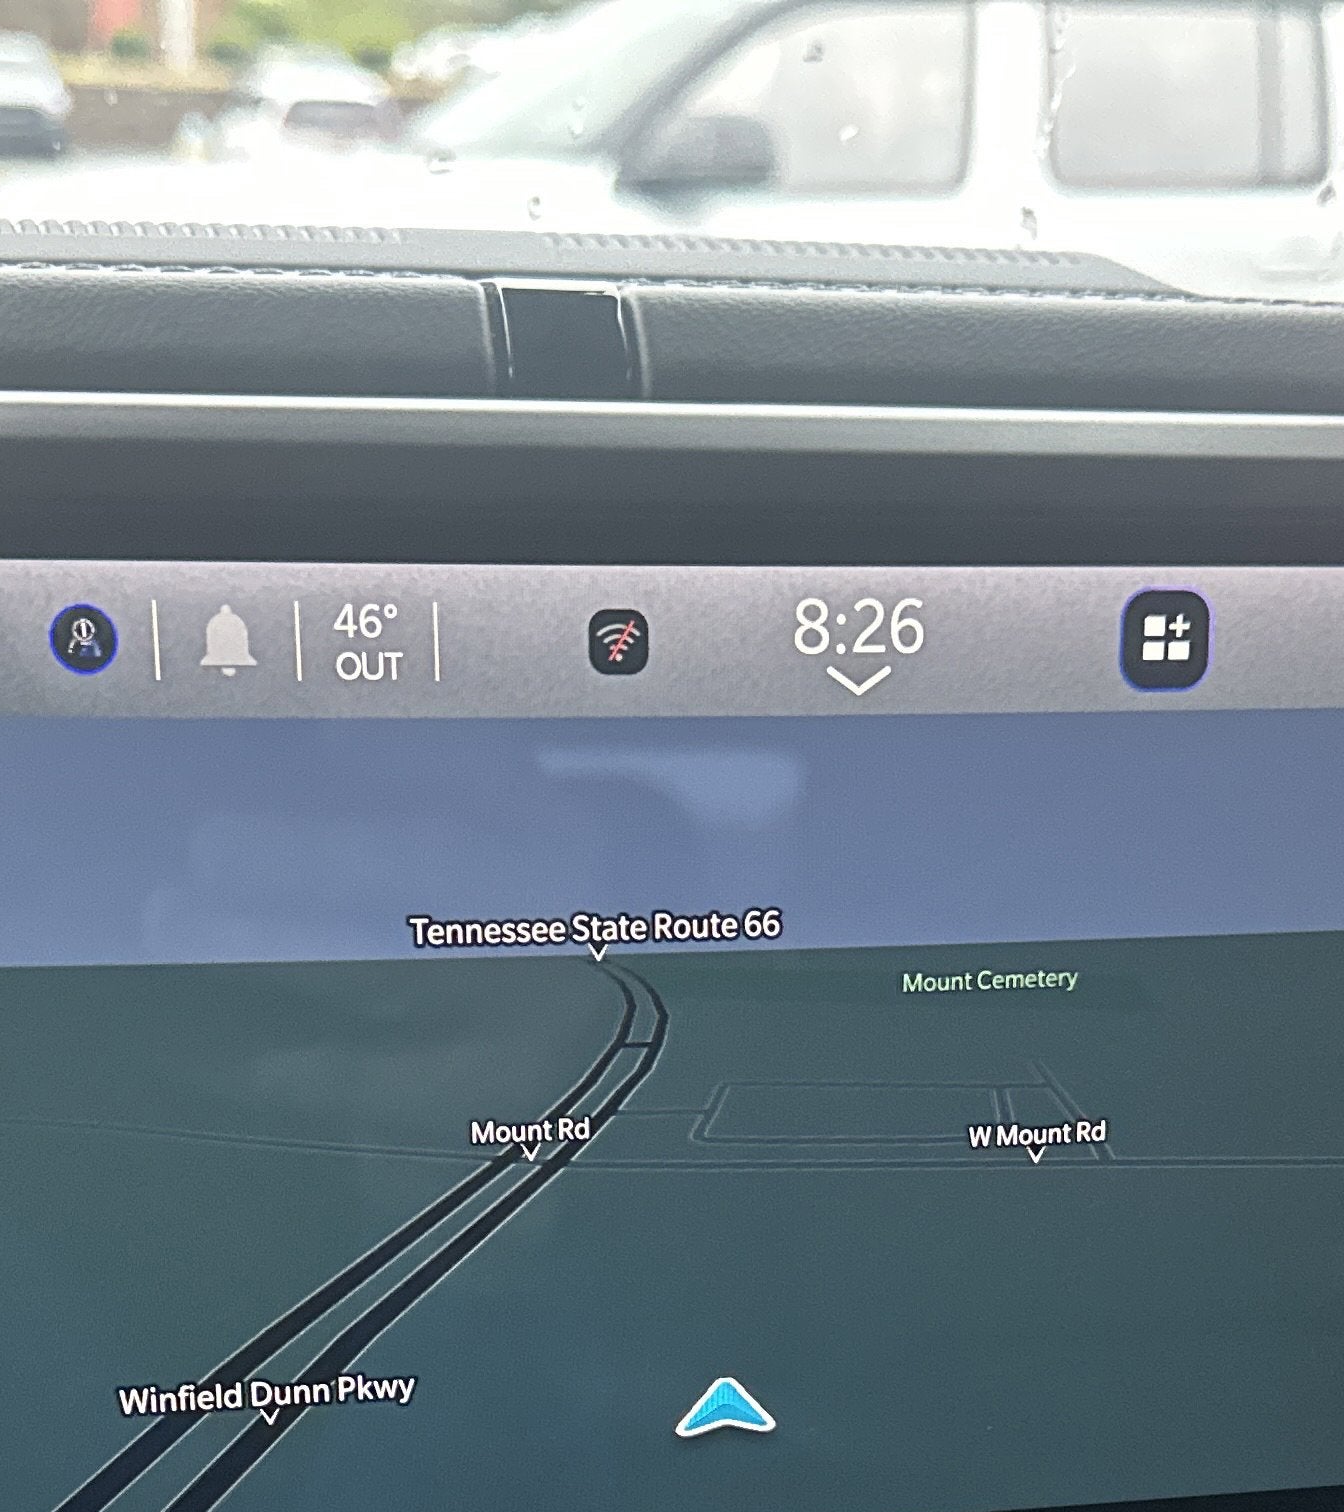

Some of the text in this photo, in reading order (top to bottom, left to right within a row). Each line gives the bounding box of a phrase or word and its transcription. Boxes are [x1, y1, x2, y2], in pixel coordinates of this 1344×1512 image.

[334, 604, 397, 638] 46°
[795, 598, 923, 654] 8:26
[336, 652, 403, 680] OUT
[409, 910, 782, 947] Tennessee State Route 66
[904, 970, 1078, 992] Mount Cemetery
[471, 1118, 591, 1145] Mount Rd
[969, 1120, 1105, 1147] W Mount Rd
[118, 1375, 414, 1415] Winfield Dunn Pkwy
